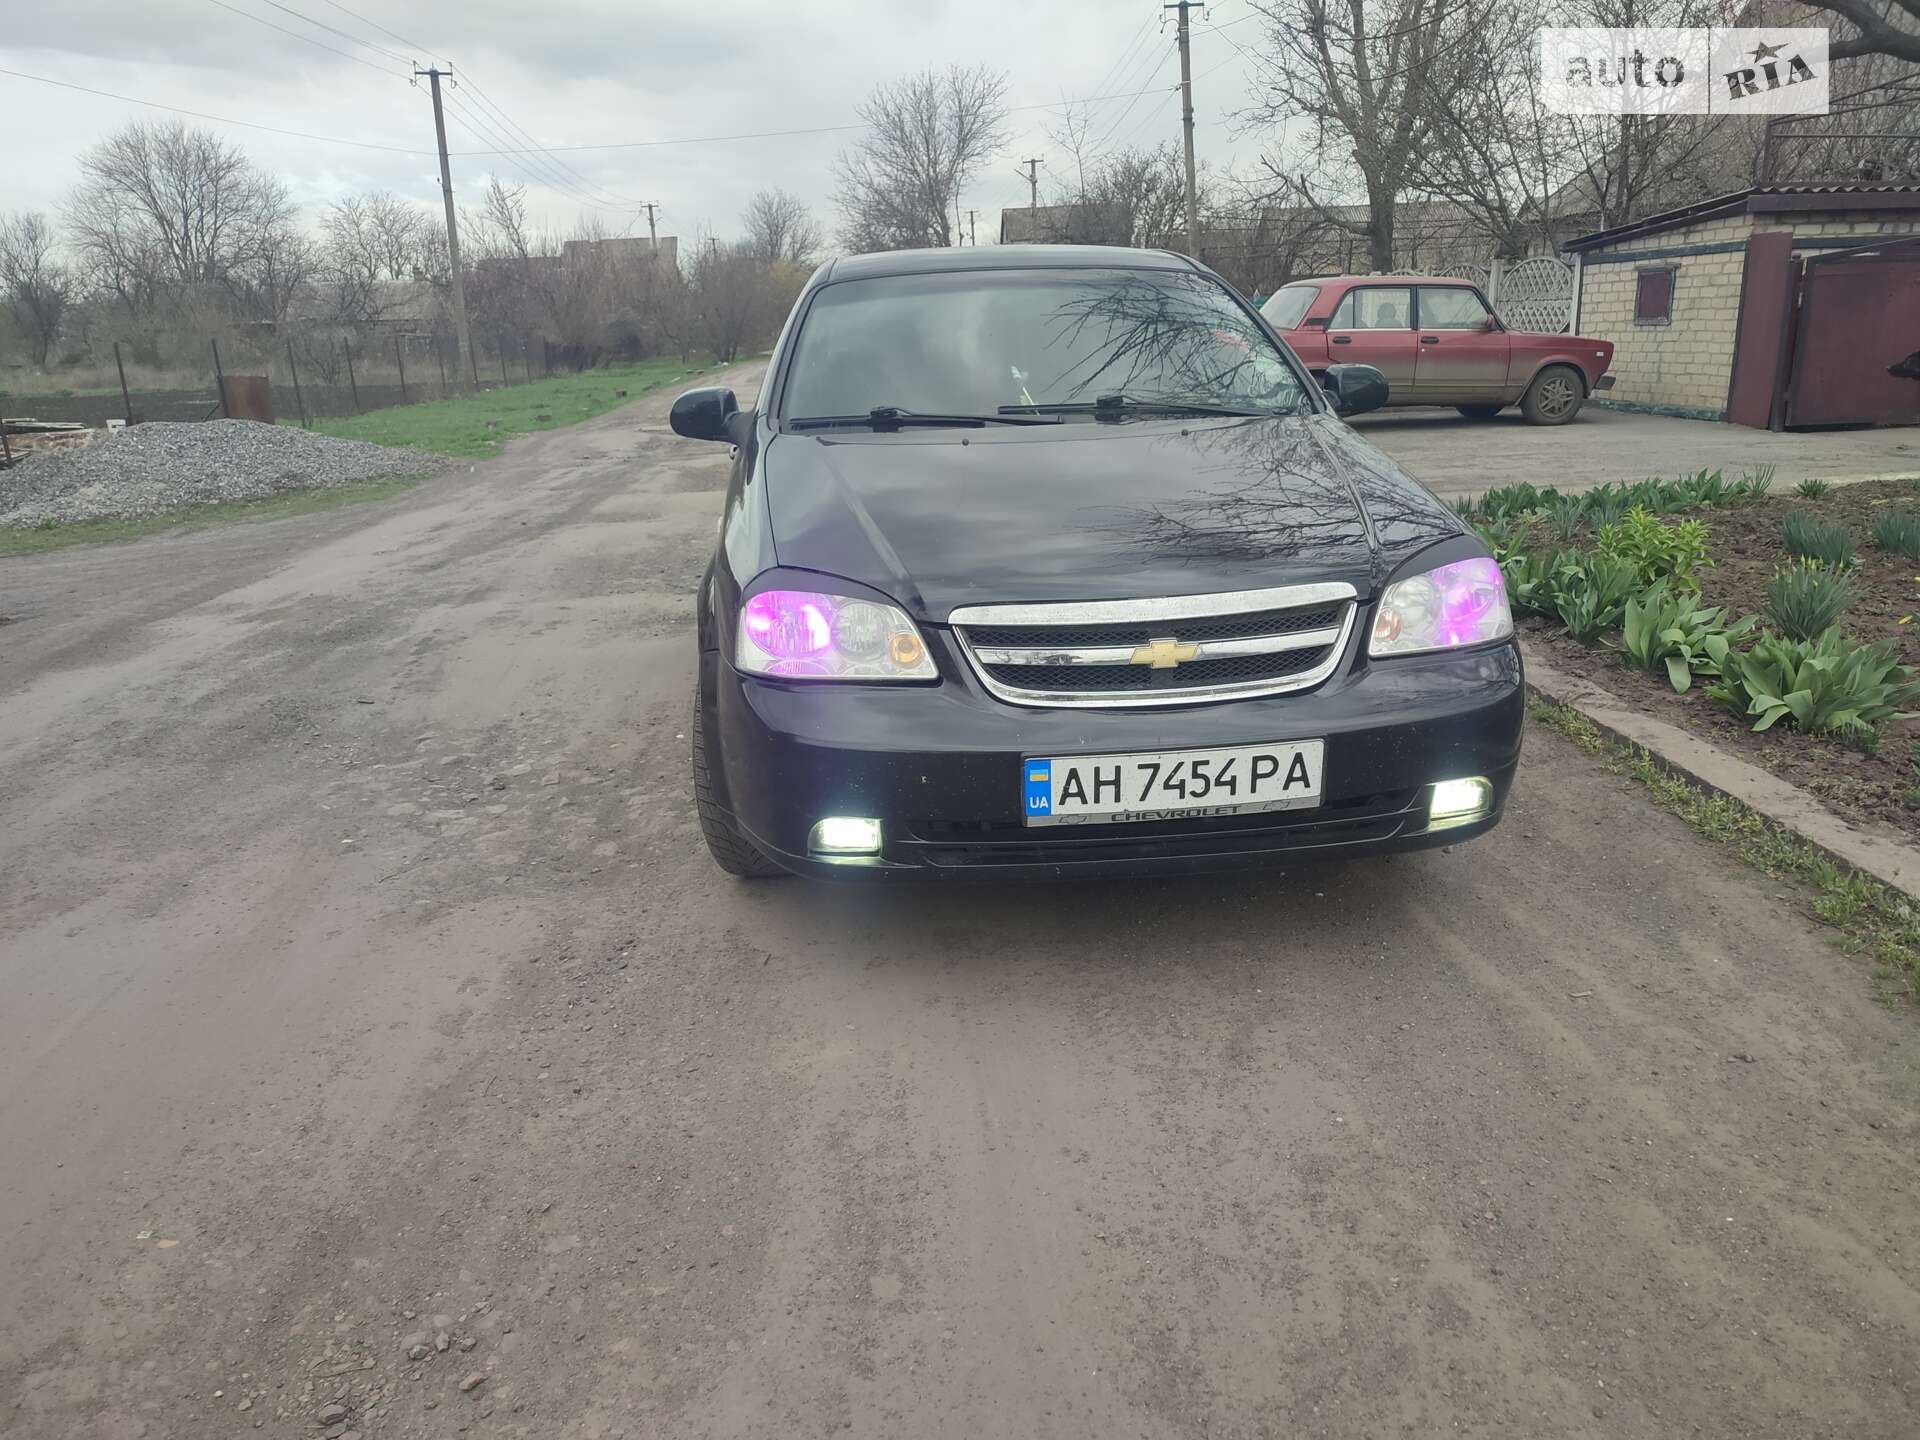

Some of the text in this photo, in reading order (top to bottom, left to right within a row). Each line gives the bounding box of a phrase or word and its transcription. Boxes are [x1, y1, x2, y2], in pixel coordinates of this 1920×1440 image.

[1058, 751, 1311, 806] AH 7454 PA
[1029, 796, 1049, 809] UA
[1111, 805, 1241, 822] CHEVROLET
